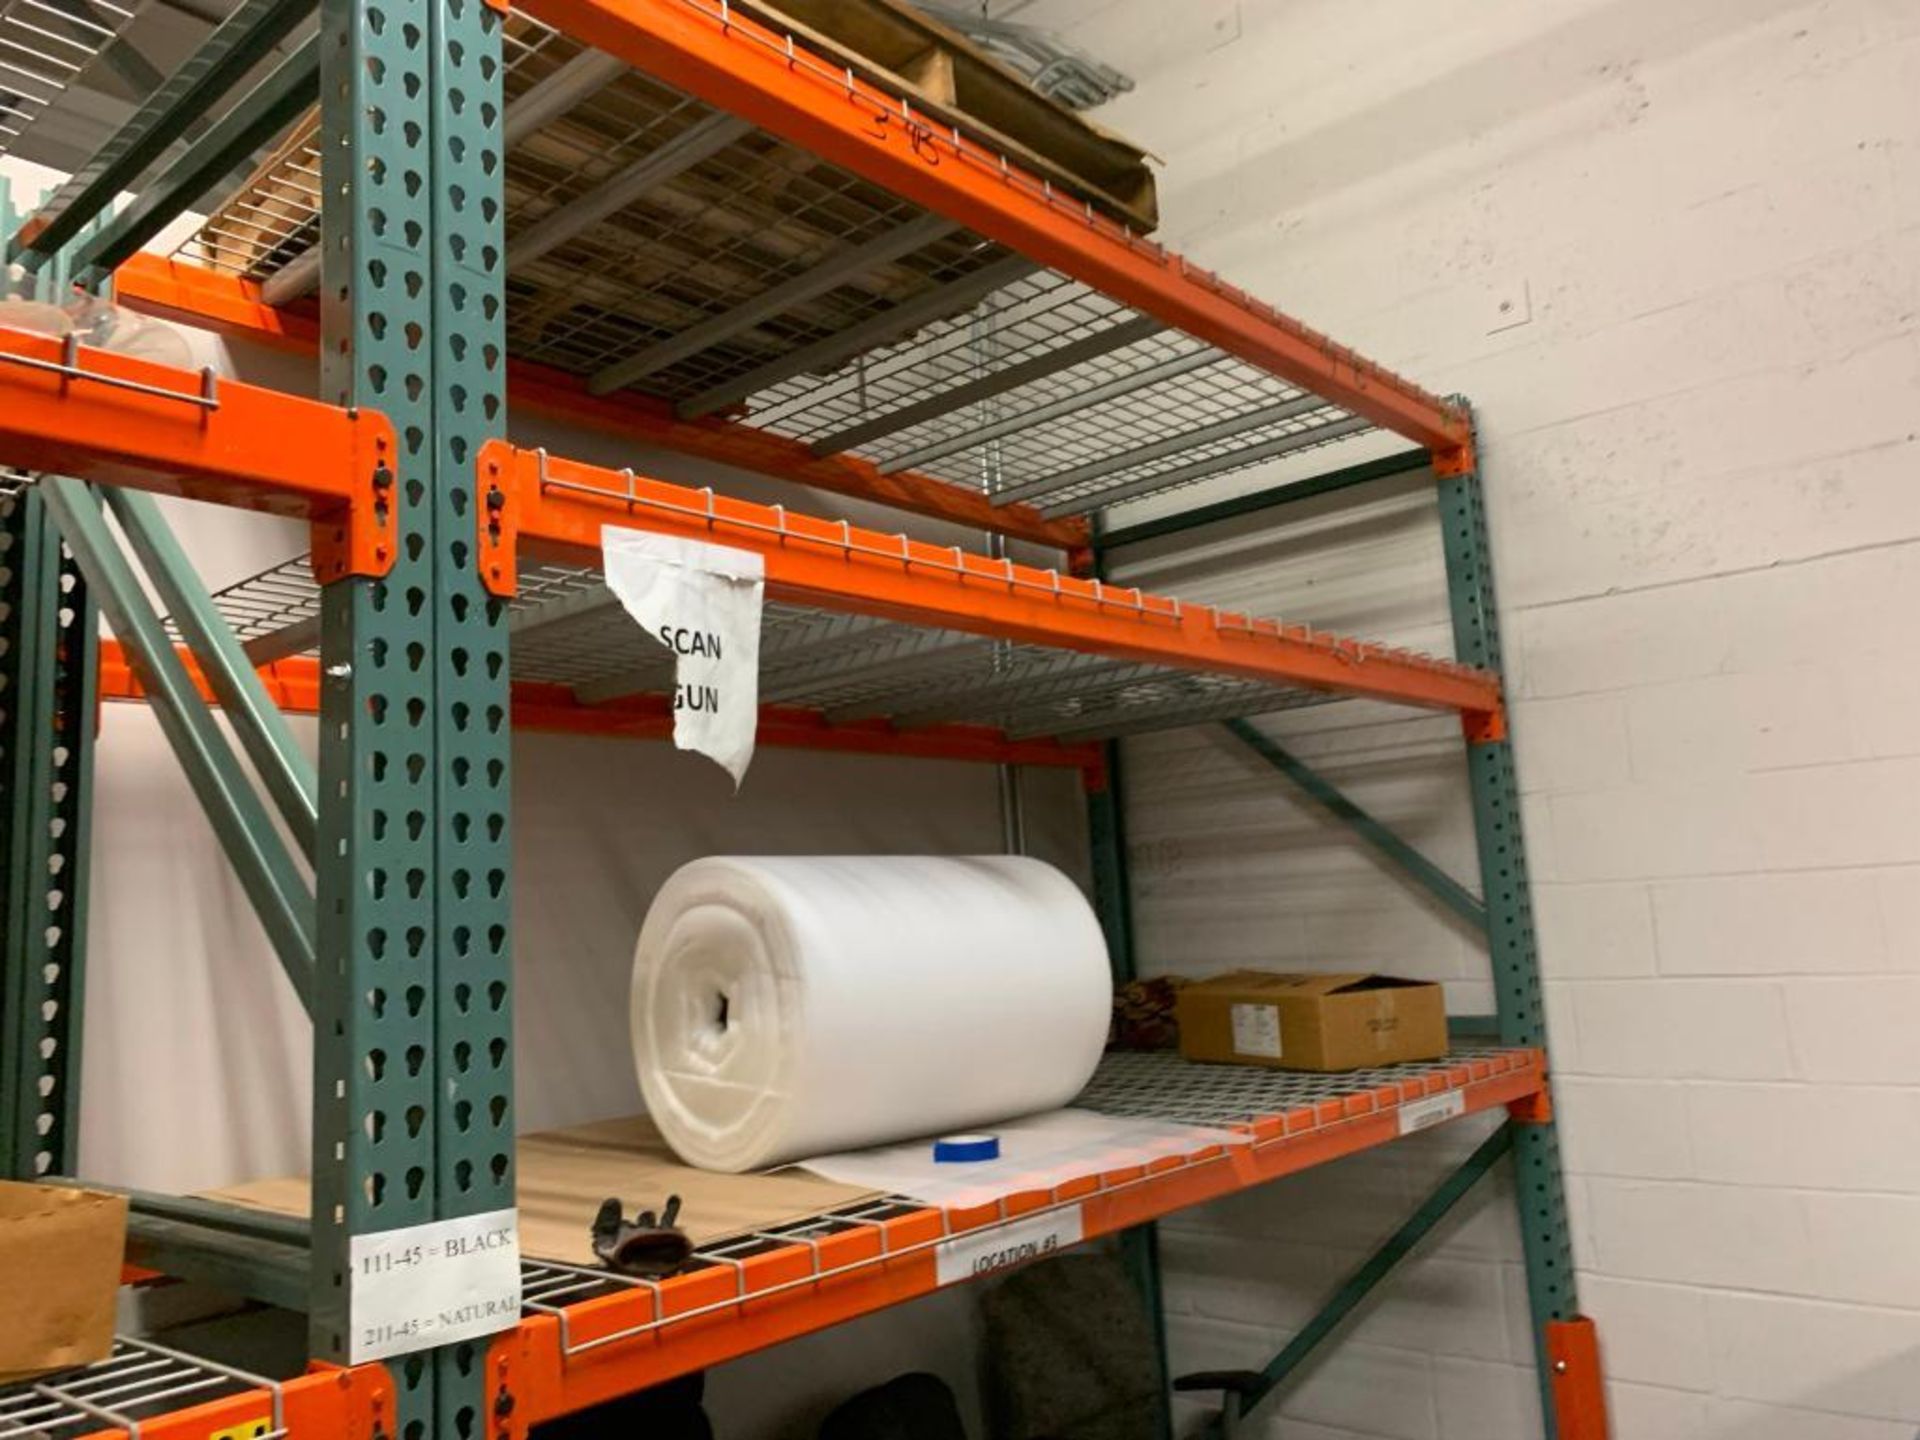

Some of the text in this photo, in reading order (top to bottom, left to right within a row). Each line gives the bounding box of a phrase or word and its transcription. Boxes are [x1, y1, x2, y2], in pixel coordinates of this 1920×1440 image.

[660, 625, 722, 660] SCAN
[363, 1246, 423, 1274] 111-45
[445, 1228, 512, 1258] BLACK
[973, 1241, 1038, 1273] LOCATION
[363, 1319, 419, 1345] 211-45
[439, 1296, 519, 1328] NATURAL
